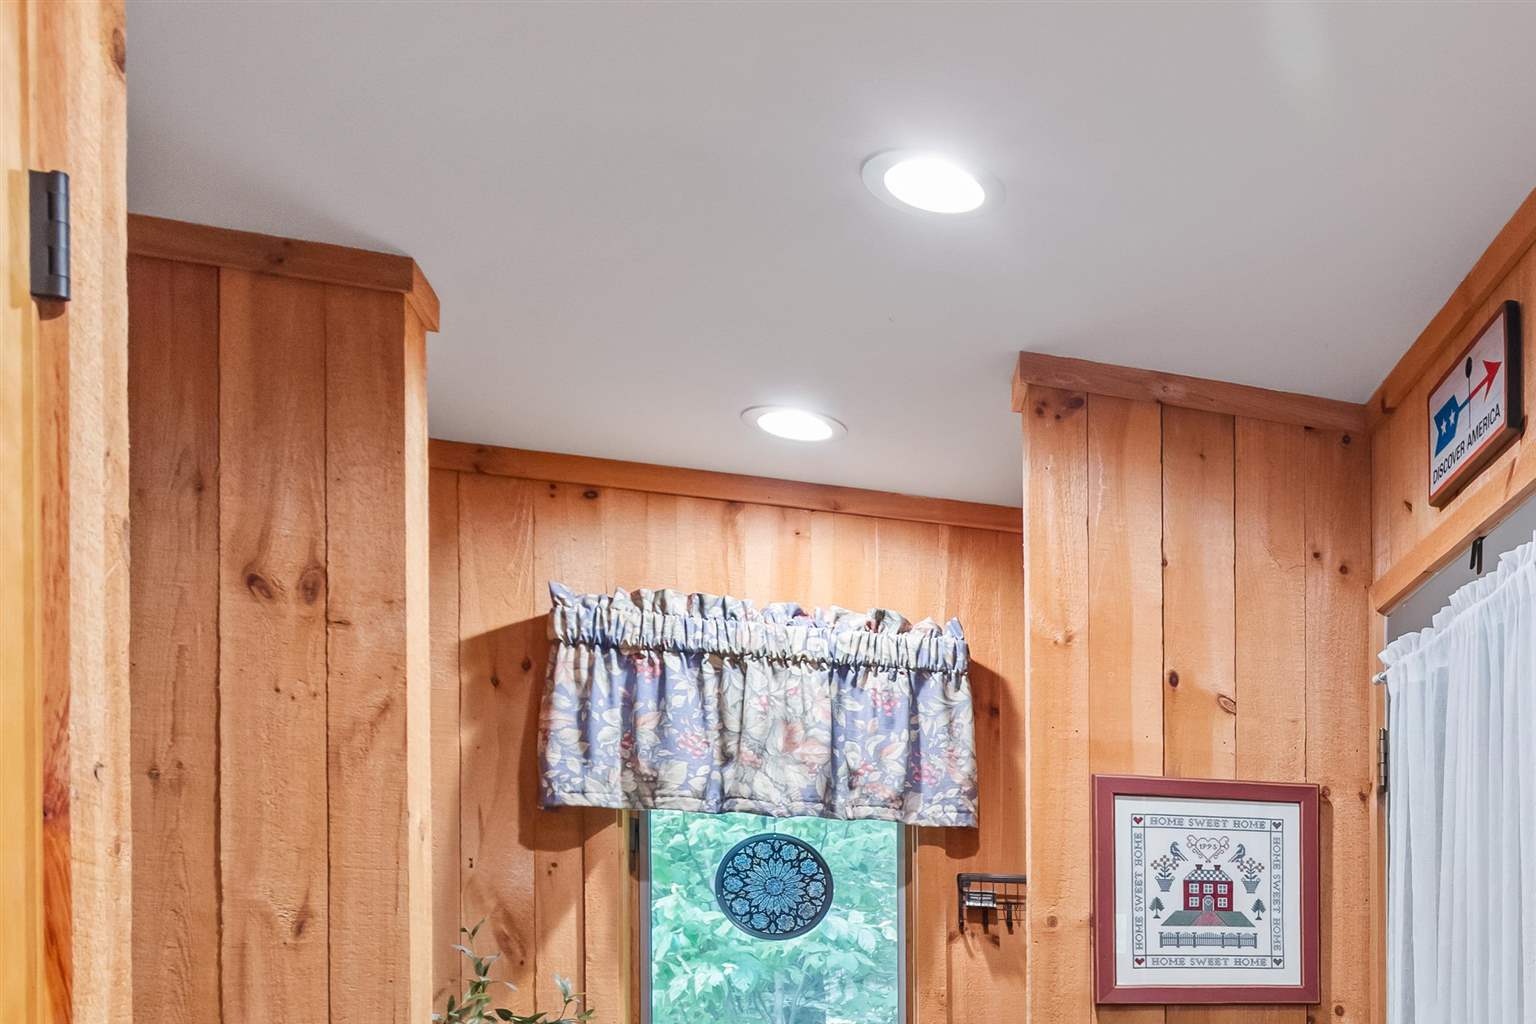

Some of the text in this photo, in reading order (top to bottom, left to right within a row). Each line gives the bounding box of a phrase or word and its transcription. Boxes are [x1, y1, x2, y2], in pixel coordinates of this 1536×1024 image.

[1433, 403, 1501, 485] DISCOVER AMERICA
[1150, 816, 1266, 830] HOME SWEET HOME
[1134, 832, 1144, 951] HOME SWEET HOME
[1272, 837, 1282, 951] HOME SWEET HOME
[1151, 957, 1267, 967] HOME SWEET HOME
